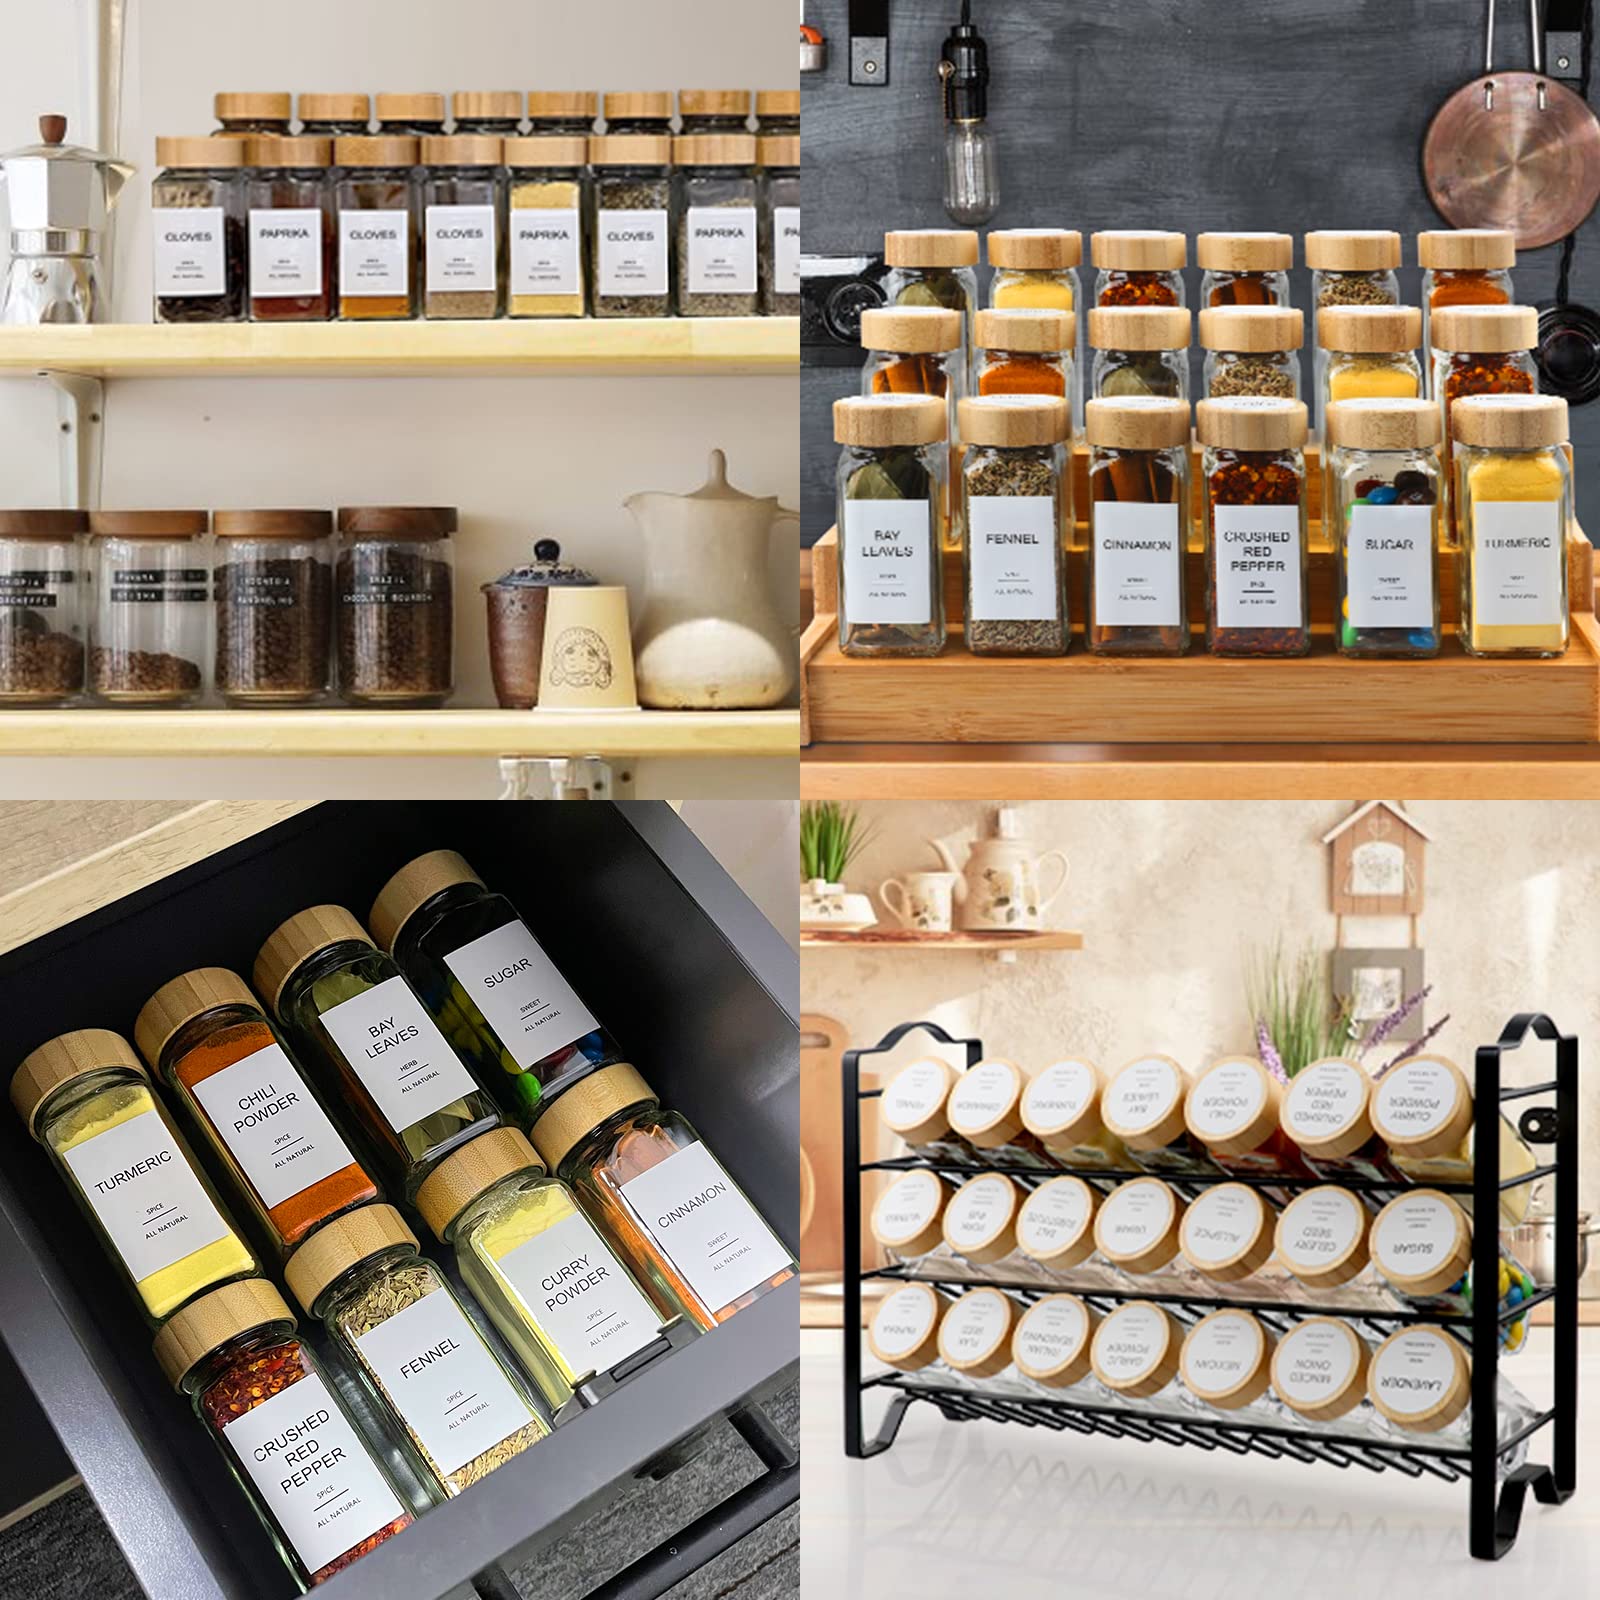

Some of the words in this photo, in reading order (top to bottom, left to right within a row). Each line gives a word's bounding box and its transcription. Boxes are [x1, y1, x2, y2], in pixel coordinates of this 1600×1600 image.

[165, 231, 212, 242] CLOVES
[259, 228, 310, 239] PAPRIKA
[350, 229, 397, 240] CLOVES
[436, 228, 483, 239] CLOVES
[519, 230, 570, 240] PAPRIKA
[607, 231, 654, 241] CLOVES
[695, 227, 745, 238] PAPRIKA
[986, 534, 1039, 544] FENNEL
[1224, 531, 1291, 543] CRUSHED
[1365, 539, 1413, 550] SUGAR
[1485, 537, 1550, 548] TURMERIC
[1103, 539, 1172, 551] CINNAMON
[1243, 546, 1272, 557] RED
[1231, 561, 1286, 572] PEPPER
[484, 958, 532, 989] SUGAR
[519, 998, 542, 1013] SWEET
[368, 1016, 396, 1038] BAY
[524, 1023, 536, 1033] ALL
[534, 1010, 561, 1027] NATURAL
[365, 1025, 419, 1059] LEAVES
[399, 1059, 418, 1073] HERB
[401, 1086, 413, 1094] ALL
[412, 1070, 440, 1088] NATURAL
[238, 1084, 277, 1110] CHILI
[1389, 1097, 1440, 1110] POWDER
[233, 1091, 300, 1133] POWDER
[1391, 1111, 1431, 1121] CURRY
[274, 1132, 292, 1146] SPICE
[274, 1160, 287, 1169] ALL
[286, 1144, 315, 1162] NATURAL
[94, 1150, 172, 1194] TURMERIC
[146, 1202, 164, 1216] SPICE
[658, 1181, 727, 1229] CINNAMON
[145, 1230, 158, 1240] ALL
[157, 1214, 189, 1233] NATURAL
[707, 1232, 729, 1248] SWEET
[1393, 1242, 1434, 1255] SUGAR
[713, 1263, 725, 1272] ALL
[723, 1245, 752, 1265] NATURAL
[541, 1254, 590, 1291] CURRY
[545, 1266, 611, 1312] POWDER
[586, 1308, 604, 1322] SPICE
[589, 1338, 602, 1348] ALL
[600, 1319, 629, 1340] NATURAL
[400, 1338, 461, 1379] FENNEL
[1194, 1359, 1241, 1371] MEXICAN
[1295, 1359, 1331, 1371] ONION
[1380, 1376, 1442, 1391] LAVENDER
[446, 1389, 464, 1404] SPICE
[448, 1420, 461, 1430] ALL
[460, 1401, 490, 1422] NATURAL
[253, 1409, 330, 1462] CRUSHED
[284, 1439, 320, 1467] RED
[280, 1447, 347, 1494] PEPPER
[316, 1484, 336, 1500] SPICE
[317, 1518, 331, 1528] ALL
[329, 1497, 362, 1520] NATURAL
